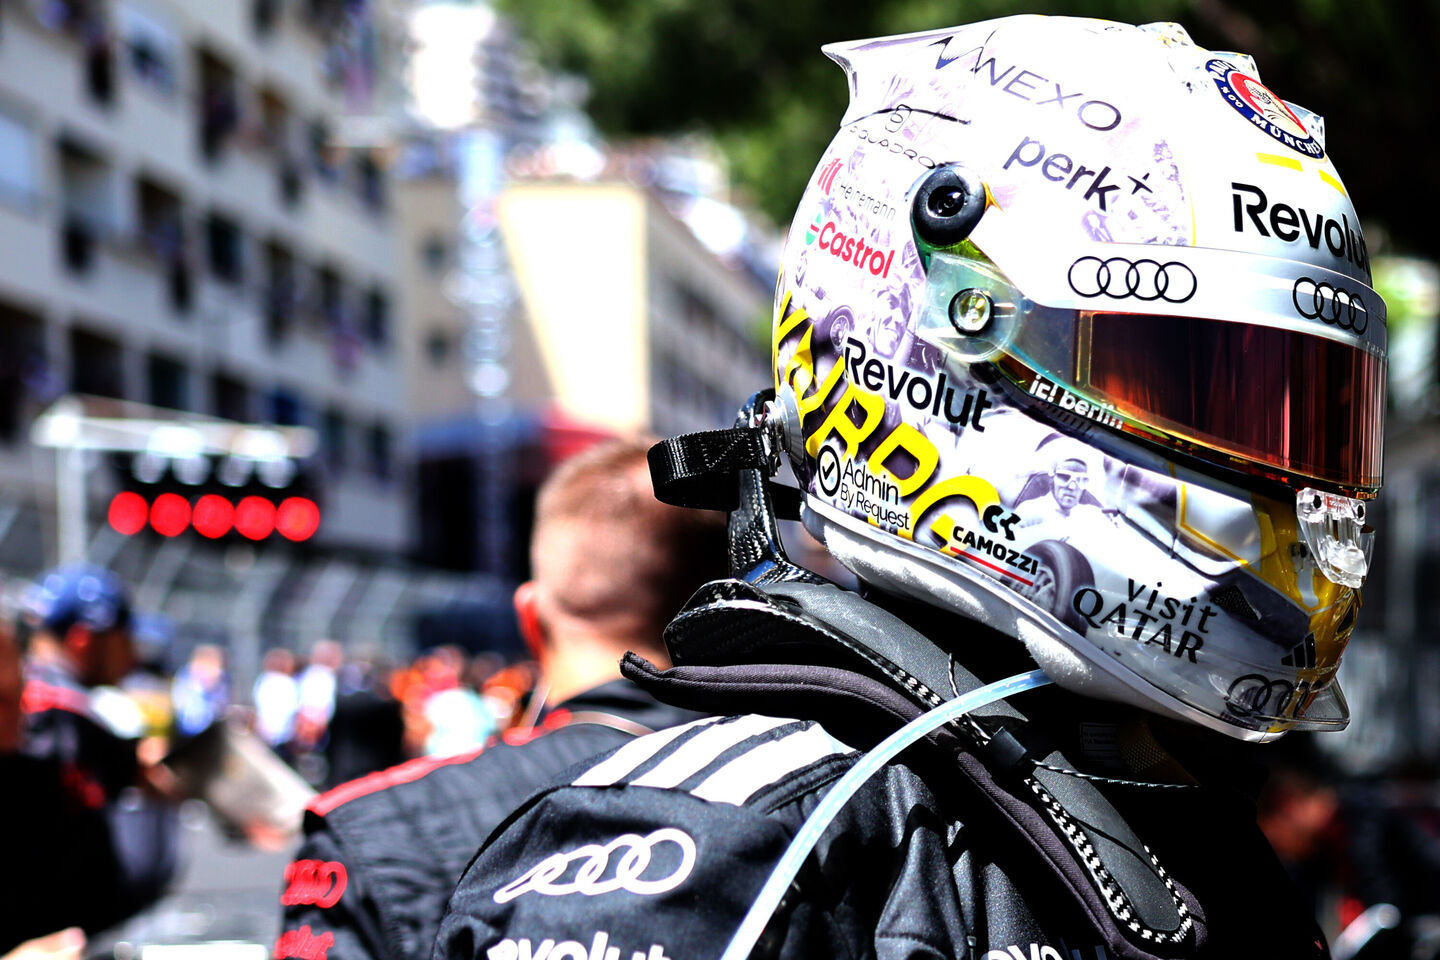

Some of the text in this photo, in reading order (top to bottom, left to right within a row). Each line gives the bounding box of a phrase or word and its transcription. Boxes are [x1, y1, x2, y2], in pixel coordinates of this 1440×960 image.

[969, 57, 1122, 132] NEXO
[818, 221, 896, 279] Castrol
[1231, 182, 1370, 275] Revolu
[844, 336, 993, 433] Revolut
[1058, 388, 1124, 430] berlin
[840, 482, 910, 531] By Request
[842, 457, 899, 506] Admin
[952, 525, 1039, 576] CAMOZZI
[1072, 588, 1204, 664] QATAR
[1128, 578, 1218, 634] visit
